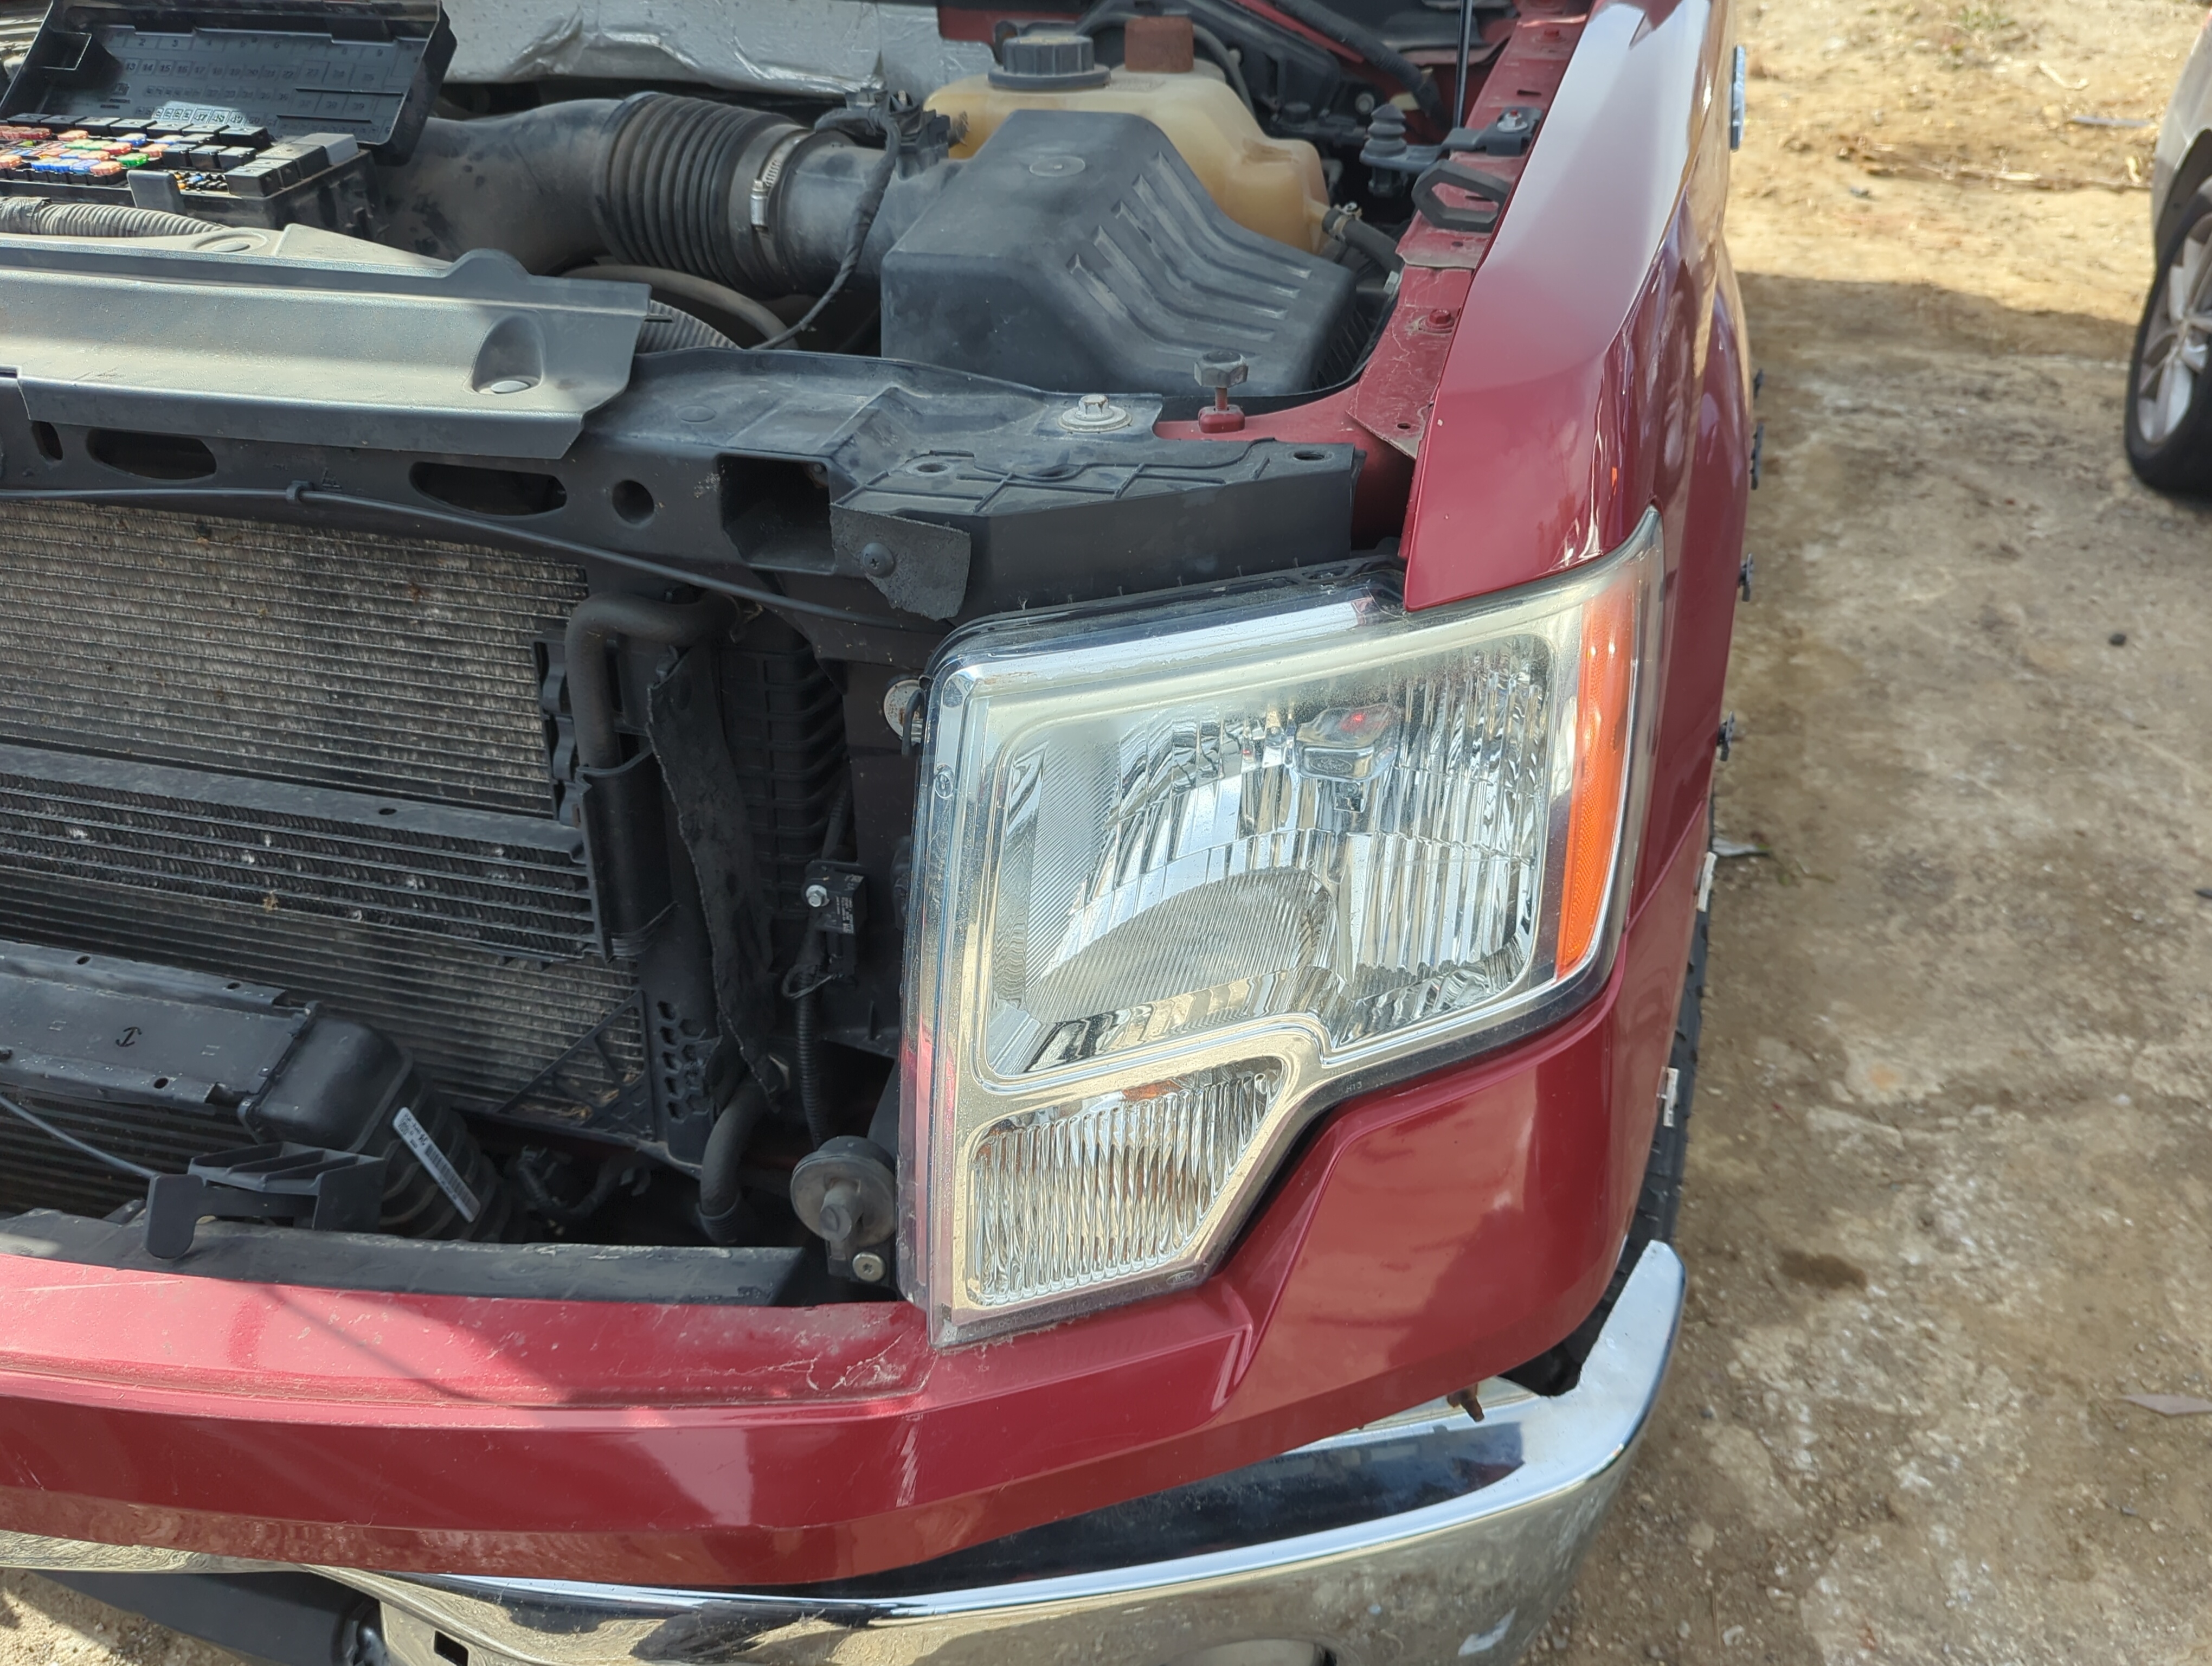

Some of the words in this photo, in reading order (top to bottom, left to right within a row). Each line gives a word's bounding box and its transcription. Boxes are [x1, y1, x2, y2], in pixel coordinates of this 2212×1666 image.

[172, 39, 178, 47] 3
[125, 62, 136, 71] 13
[142, 63, 153, 72] 14
[159, 64, 172, 72] 15
[194, 113, 208, 121] 47
[211, 114, 226, 123] 48
[229, 114, 243, 124] 49
